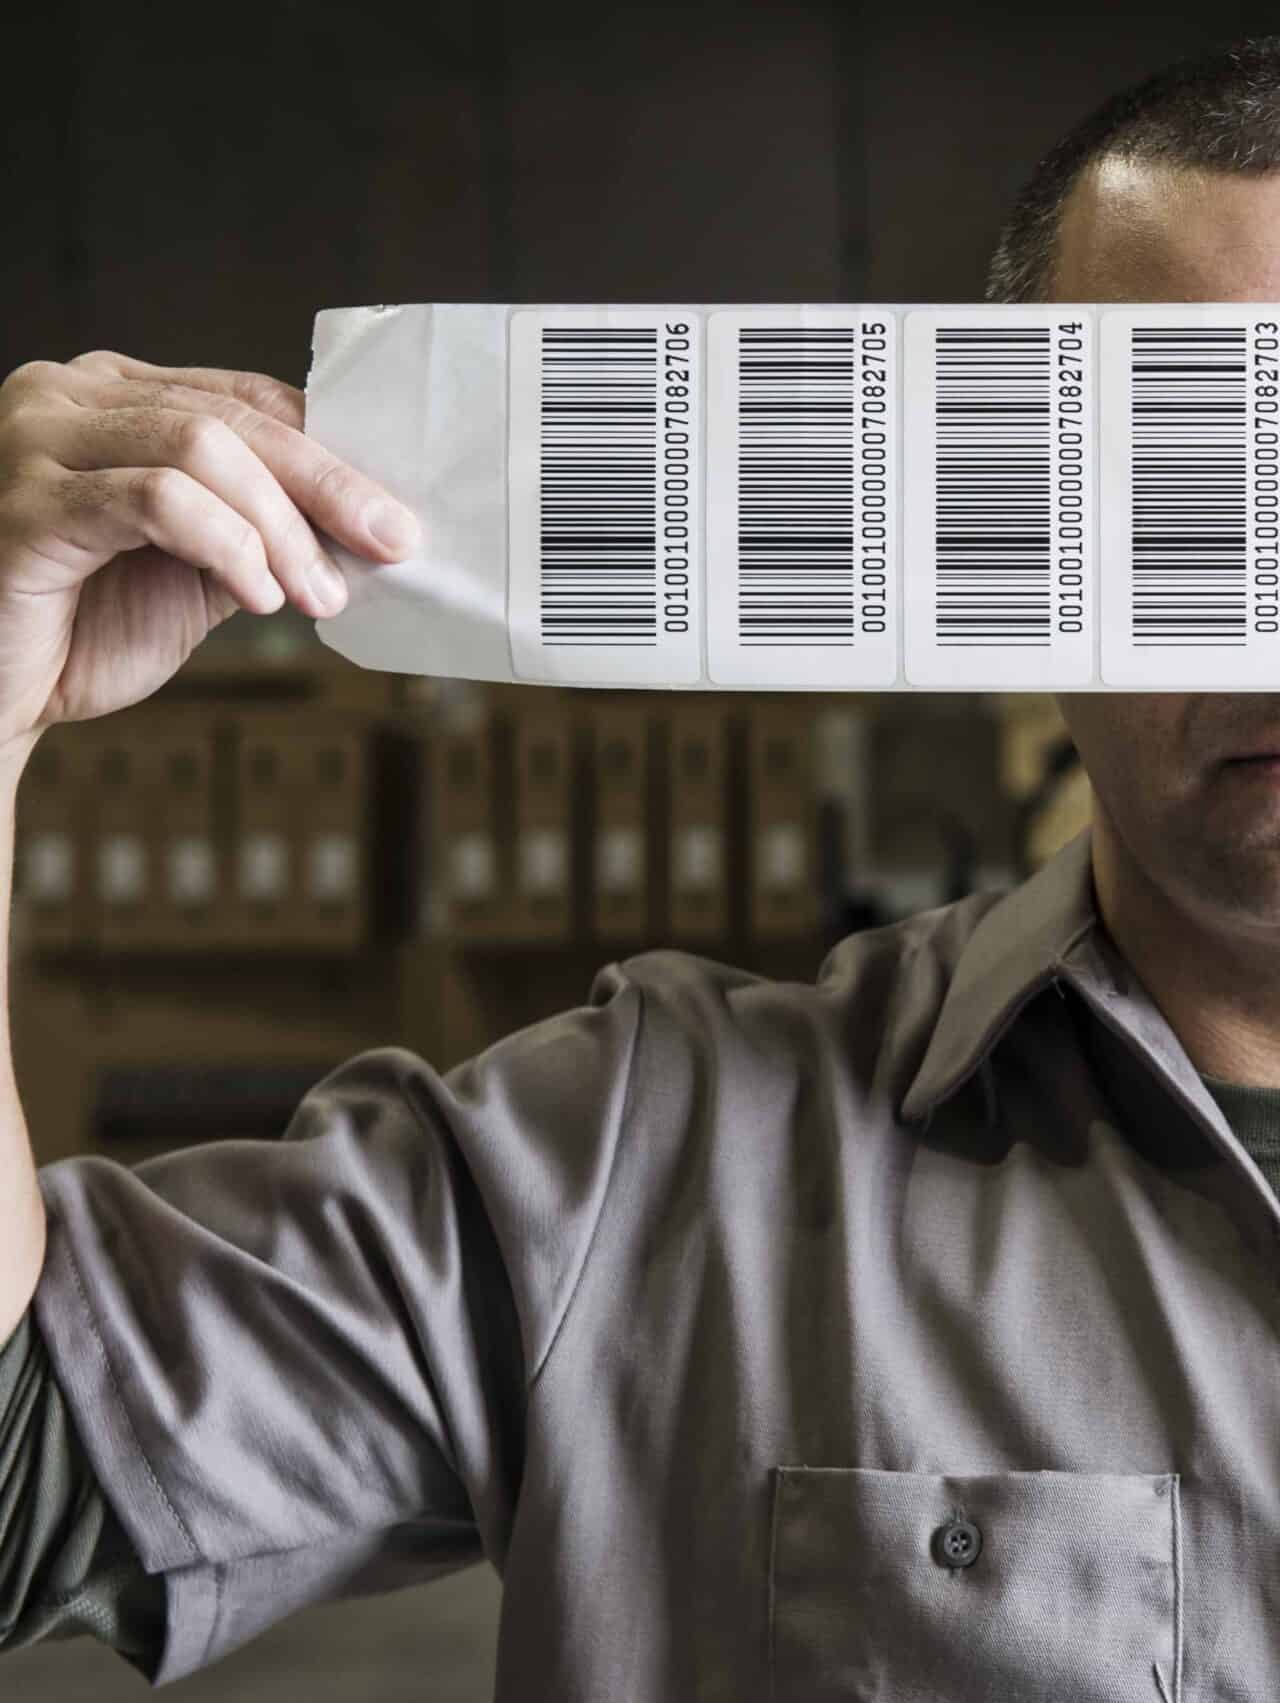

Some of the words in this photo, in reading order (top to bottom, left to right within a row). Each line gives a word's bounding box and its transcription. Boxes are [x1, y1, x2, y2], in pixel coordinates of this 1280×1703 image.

[664, 323, 690, 633] 00100100000007082706
[861, 323, 886, 633] 00100100000007082705
[1058, 322, 1083, 633] 00100100000007082704
[1255, 322, 1279, 633] 00100100000007082703
